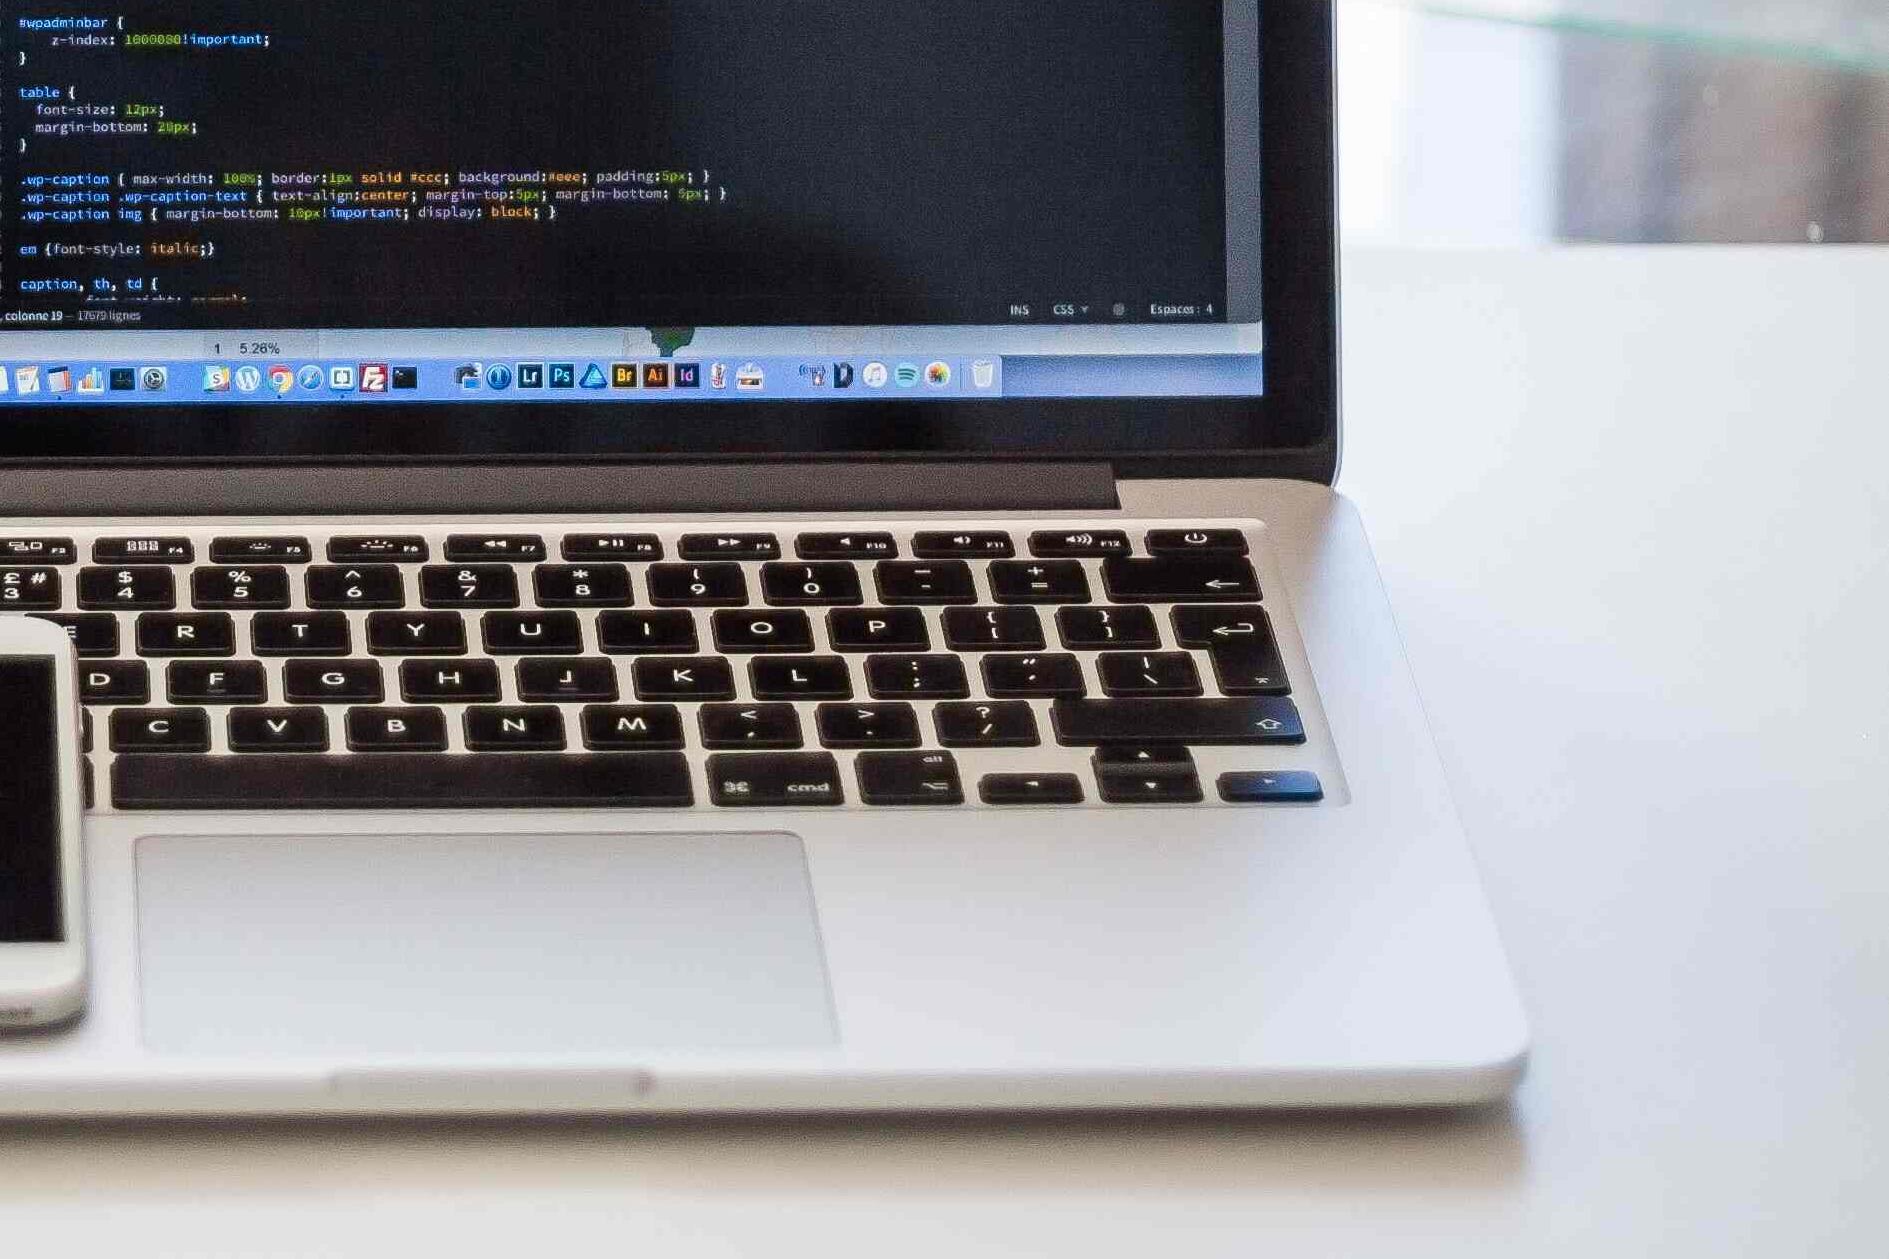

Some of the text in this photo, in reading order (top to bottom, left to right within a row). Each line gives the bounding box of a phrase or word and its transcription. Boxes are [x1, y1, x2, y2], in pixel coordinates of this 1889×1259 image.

[52, 34, 115, 46] z-index:
[18, 86, 60, 100] table
[37, 103, 115, 115] font-size:
[35, 121, 147, 135] margin-bottom:
[21, 173, 110, 188] .wp-caption
[133, 173, 213, 184] max-width:
[361, 172, 402, 183] solid
[21, 191, 110, 205] .wp-caption
[120, 190, 247, 204] .wp-caption-text
[272, 189, 416, 204] text-align:center;
[556, 188, 668, 202] margin-bottom:
[21, 205, 481, 224] .wp-caption img margin-bottom: display:
[45, 242, 214, 258] {font-style: italic;}
[20, 277, 143, 292] caption, th, td
[1011, 305, 1029, 315] INS
[1054, 305, 1074, 315] CSS
[1206, 304, 1212, 314] 4
[5, 311, 49, 321] colonne
[51, 311, 63, 321] 19
[109, 311, 141, 323] lignes
[215, 343, 280, 354] 1 5.26%
[523, 370, 535, 382] Lr
[555, 369, 569, 381] Ps
[618, 369, 631, 381] Br
[648, 370, 663, 381] Ai
[681, 369, 693, 381] Id
[4, 588, 19, 599] 3
[118, 587, 133, 598] 4
[234, 587, 248, 597] 5
[347, 586, 362, 597] 6
[461, 586, 475, 596] 7
[576, 585, 590, 595] 8
[691, 584, 705, 594] 9
[804, 583, 820, 593] 0
[178, 626, 194, 638] R
[292, 625, 307, 637] T
[407, 624, 424, 636] Y
[521, 624, 541, 635] U
[751, 622, 773, 634] O
[869, 621, 885, 632] P
[90, 673, 110, 685] D
[210, 673, 223, 685] F
[322, 673, 345, 685] G
[439, 672, 459, 684] H
[560, 671, 572, 683] J
[674, 670, 693, 681] K
[792, 669, 807, 681] L
[149, 721, 168, 733] C
[267, 720, 287, 732] V
[388, 720, 405, 732] B
[503, 719, 525, 731] N
[618, 718, 646, 730] M
[788, 783, 829, 792] cmd
